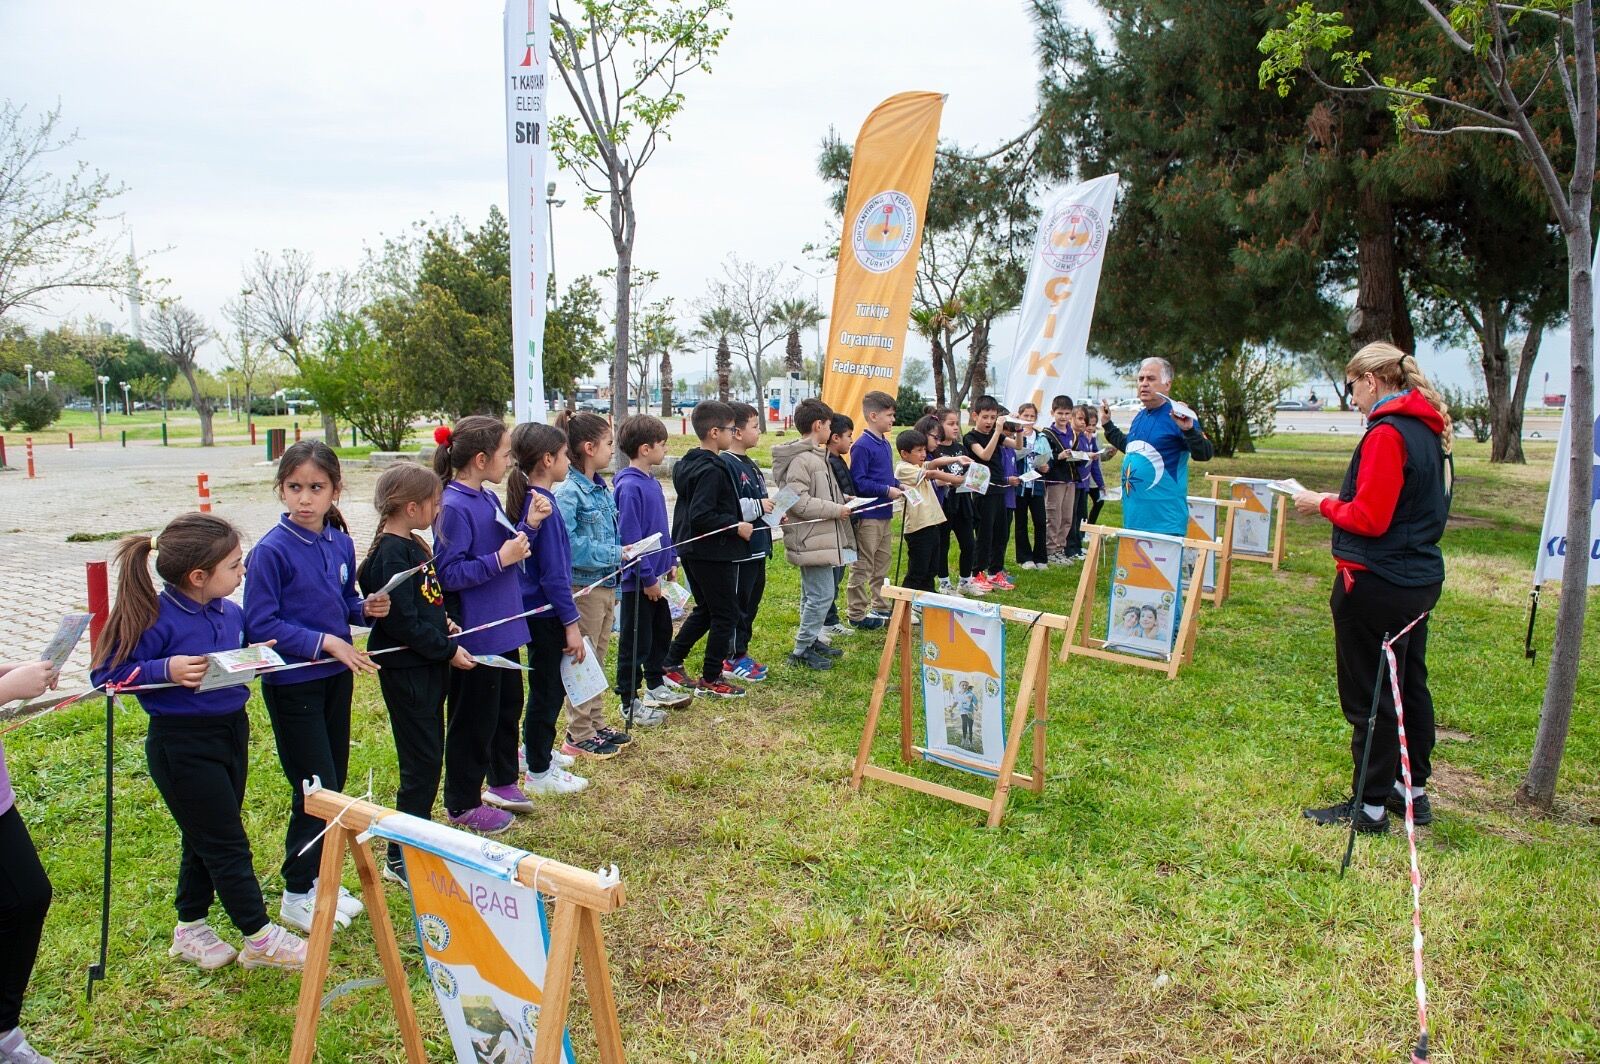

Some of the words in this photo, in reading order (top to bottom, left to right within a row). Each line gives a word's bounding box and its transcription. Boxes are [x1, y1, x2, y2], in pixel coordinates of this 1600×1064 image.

[855, 303, 890, 320] Türkiye
[1027, 275, 1073, 411] ÇIKI
[831, 359, 894, 379] Federasyonu
